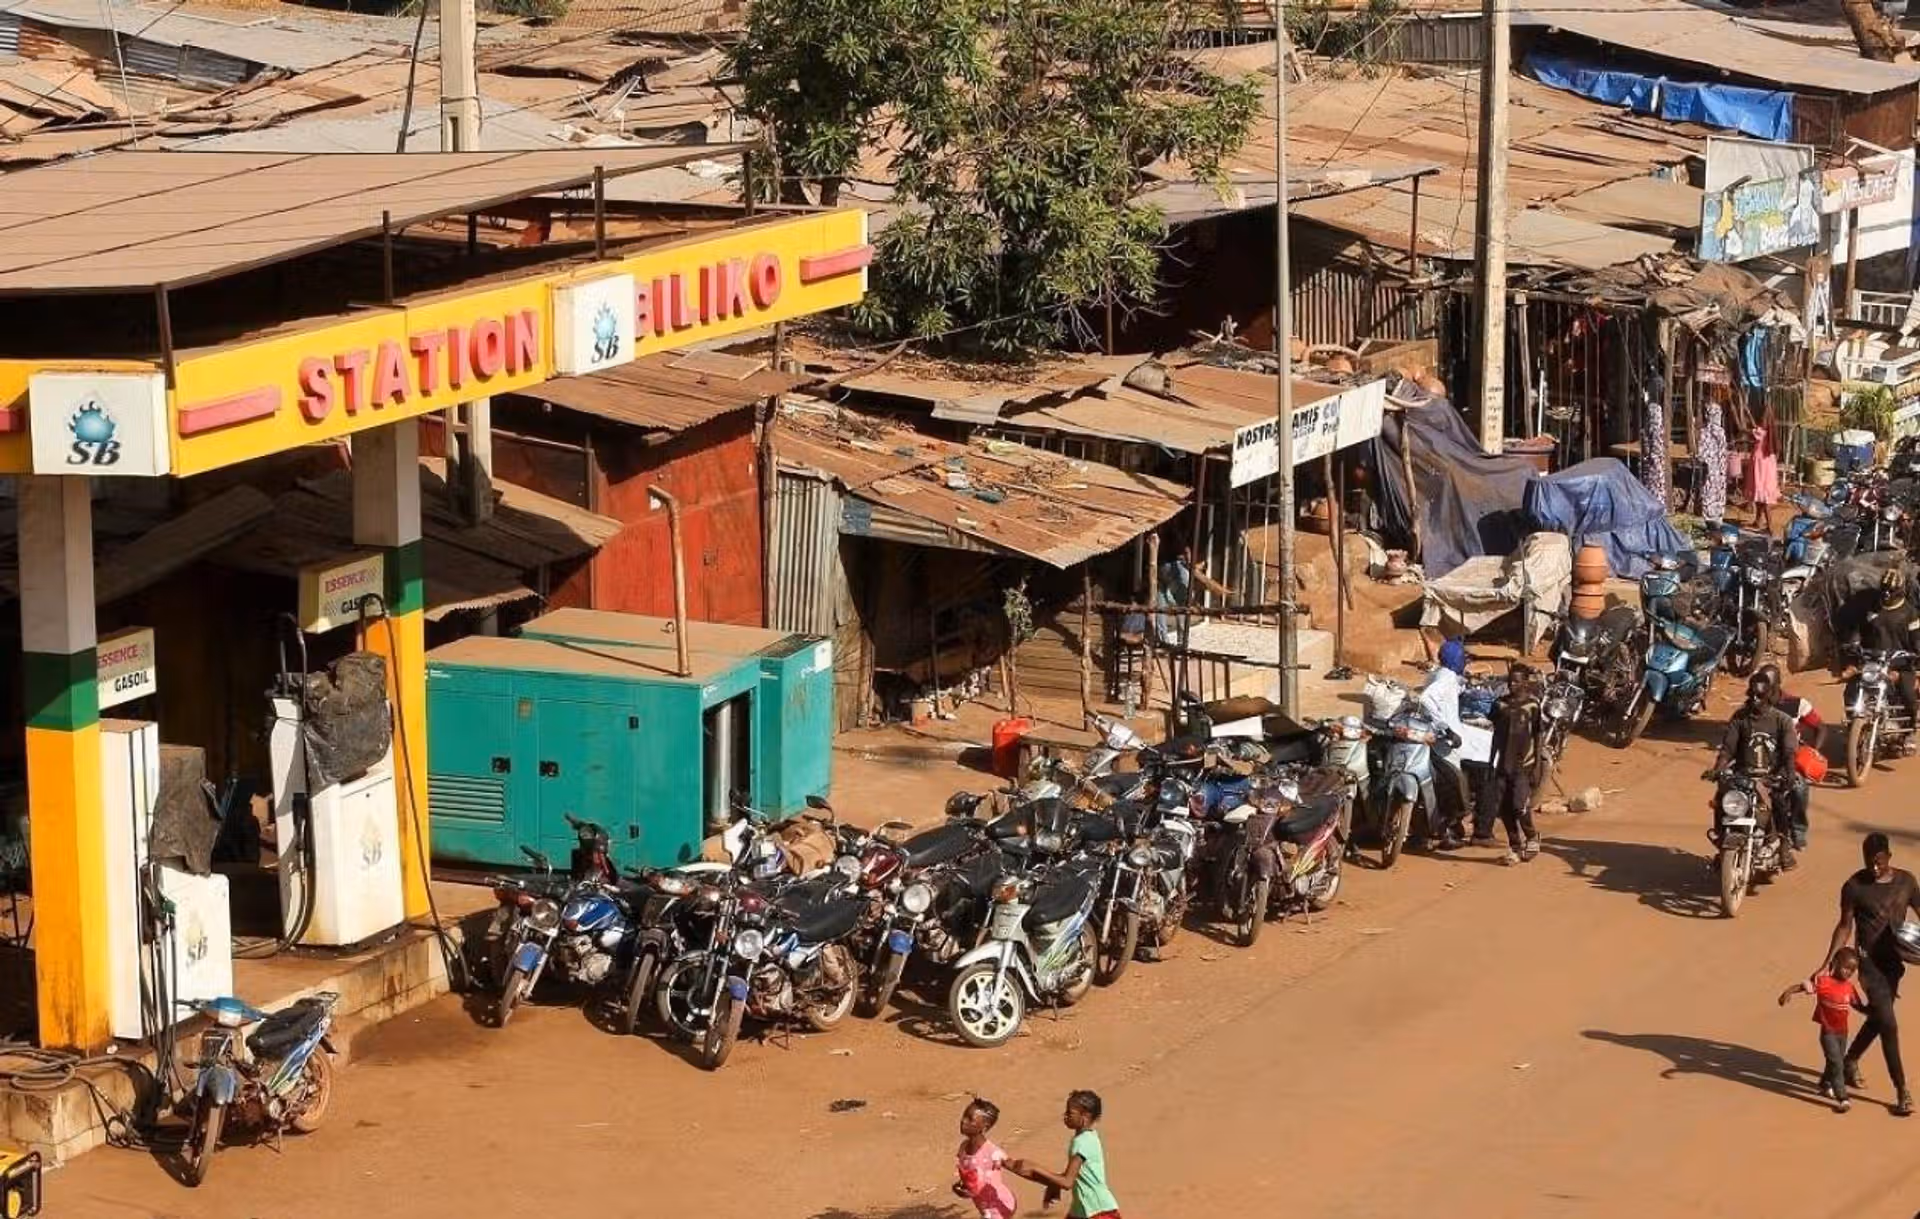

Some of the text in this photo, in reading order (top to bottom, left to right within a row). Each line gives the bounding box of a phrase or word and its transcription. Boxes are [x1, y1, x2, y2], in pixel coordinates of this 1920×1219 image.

[300, 252, 782, 425] STATION BILIKO
[592, 335, 620, 364] SB
[66, 439, 121, 465] SB
[325, 568, 369, 594] ESSENCE
[114, 670, 149, 692] GASOIL
[186, 936, 208, 968] SB
